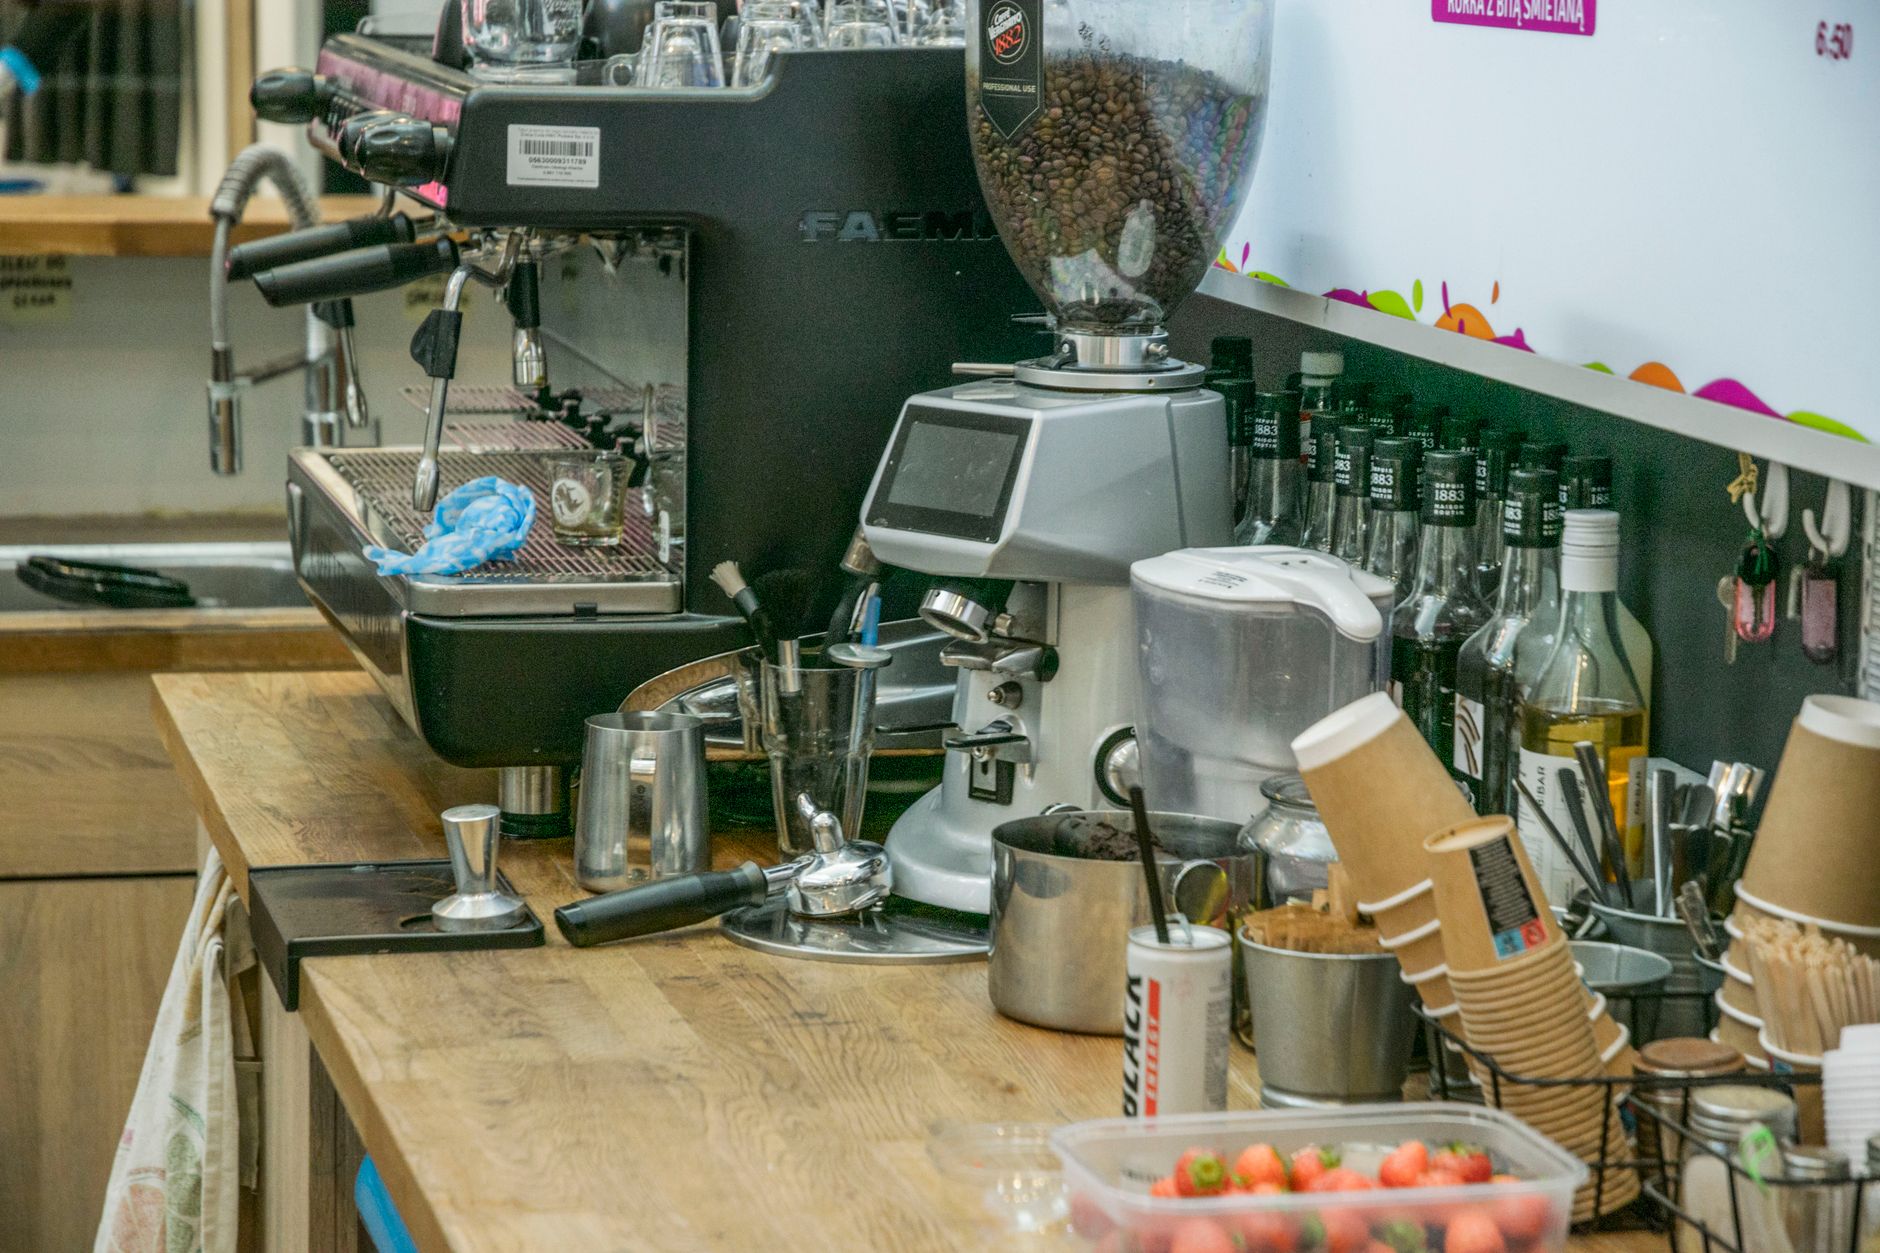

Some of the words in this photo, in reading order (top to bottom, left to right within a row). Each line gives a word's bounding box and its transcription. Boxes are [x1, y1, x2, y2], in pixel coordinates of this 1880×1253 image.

[994, 24, 1022, 57] 1882
[1022, 85, 1037, 93] USE
[800, 209, 1001, 242] FAEM
[1434, 489, 1465, 501] 1883
